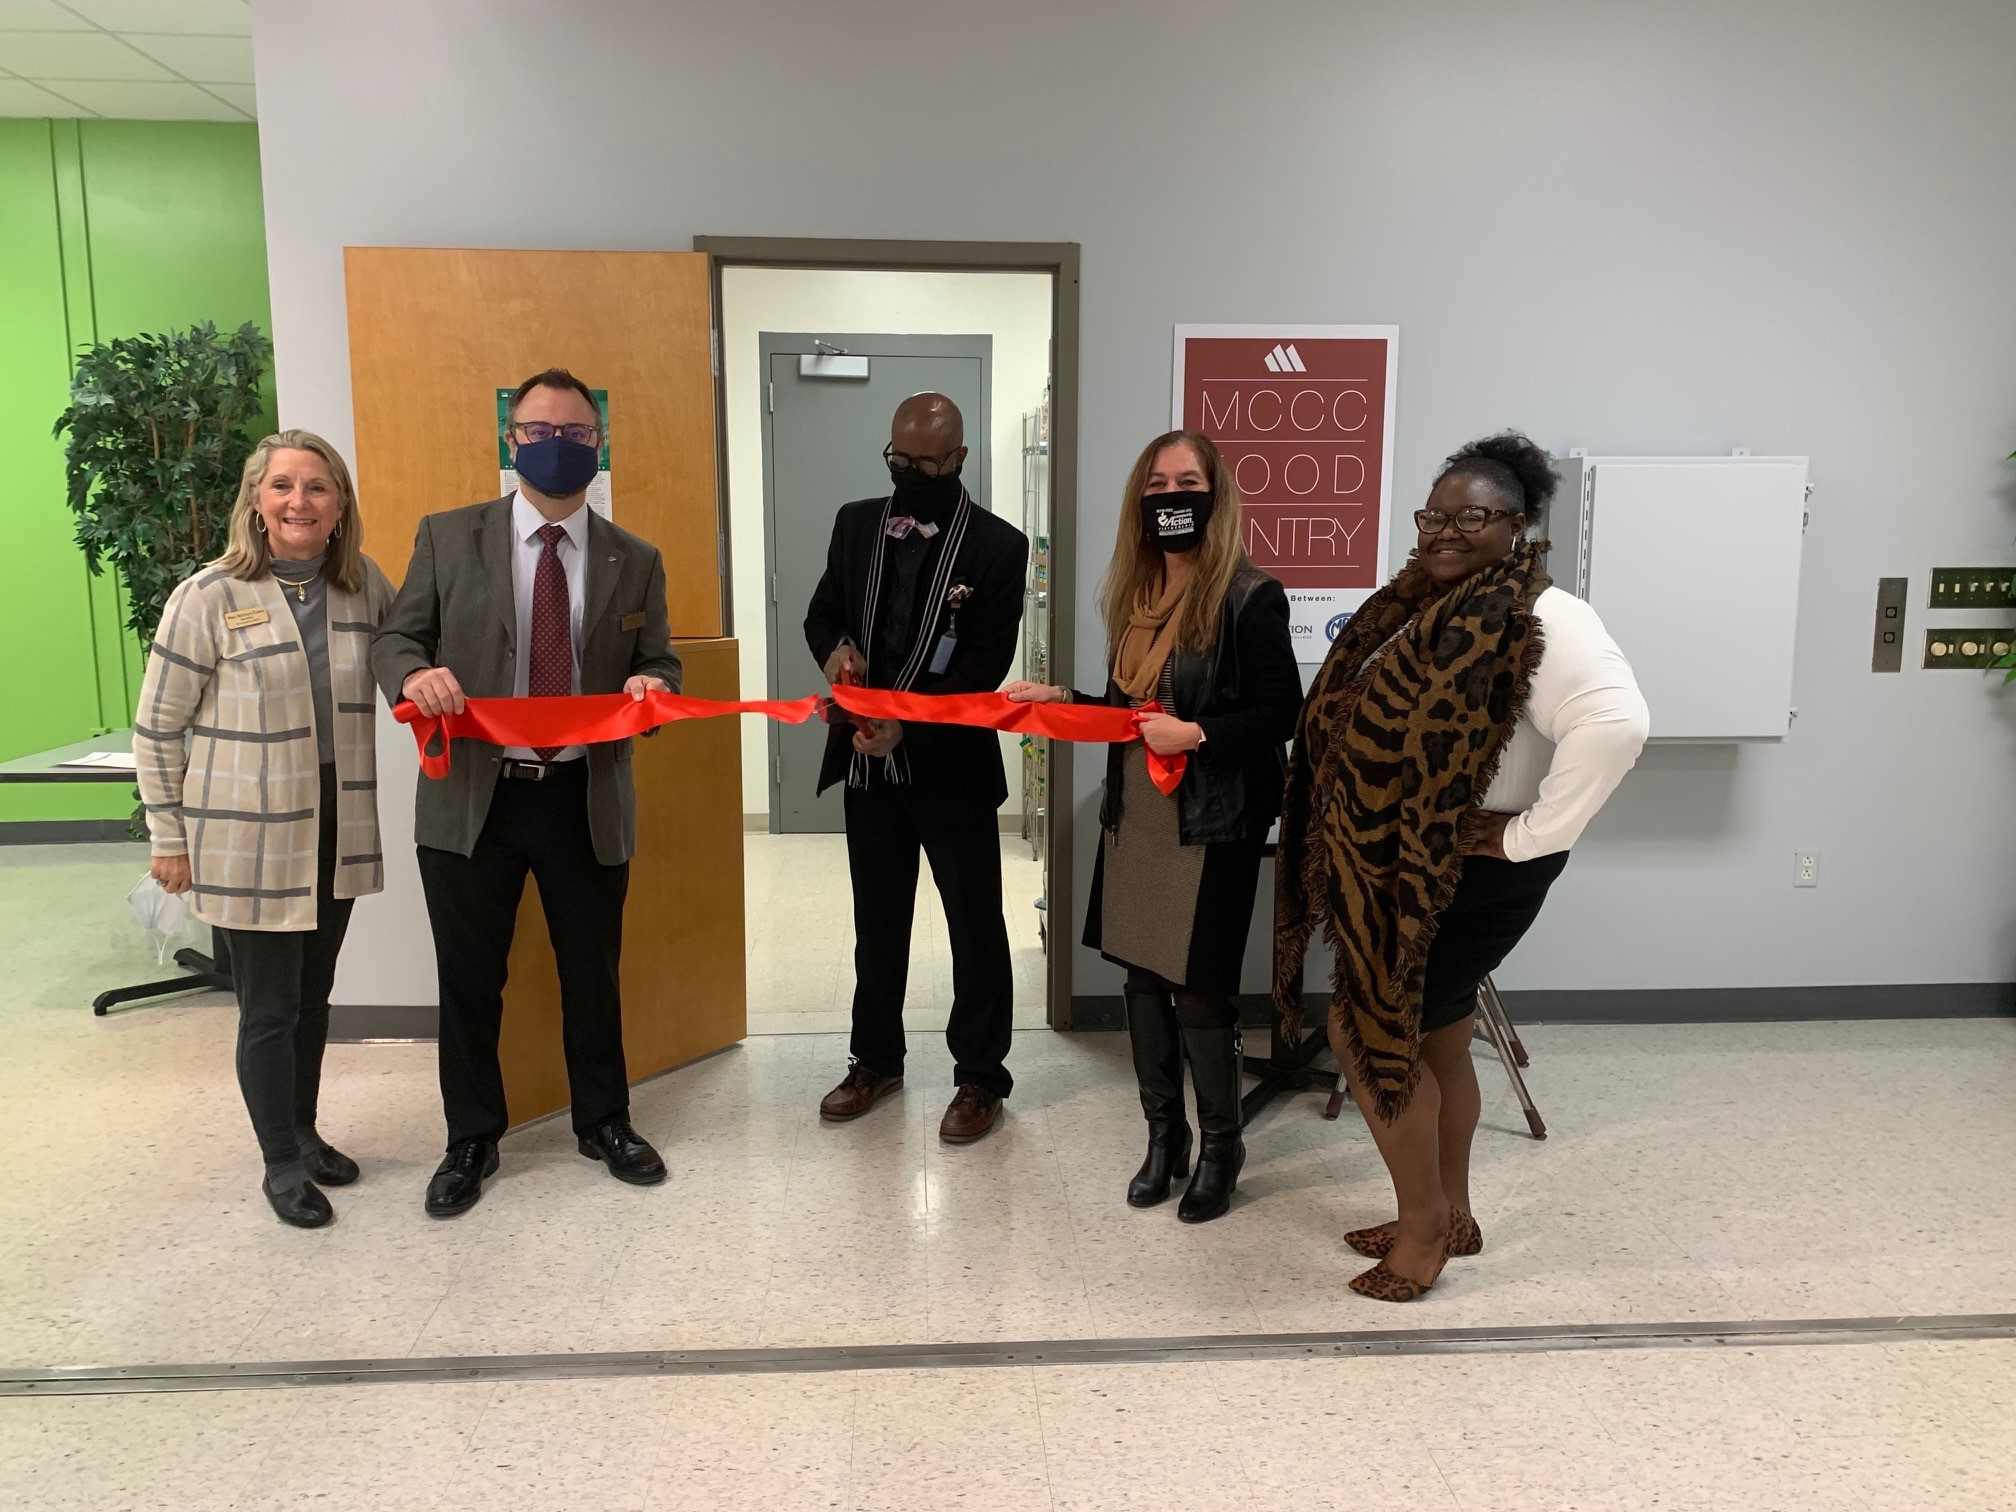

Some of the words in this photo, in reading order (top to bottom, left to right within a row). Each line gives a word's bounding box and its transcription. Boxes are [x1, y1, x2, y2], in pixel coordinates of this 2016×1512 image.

[1202, 390, 1368, 431] MCCC
[1221, 453, 1365, 495] OOD
[1166, 516, 1192, 527] Action
